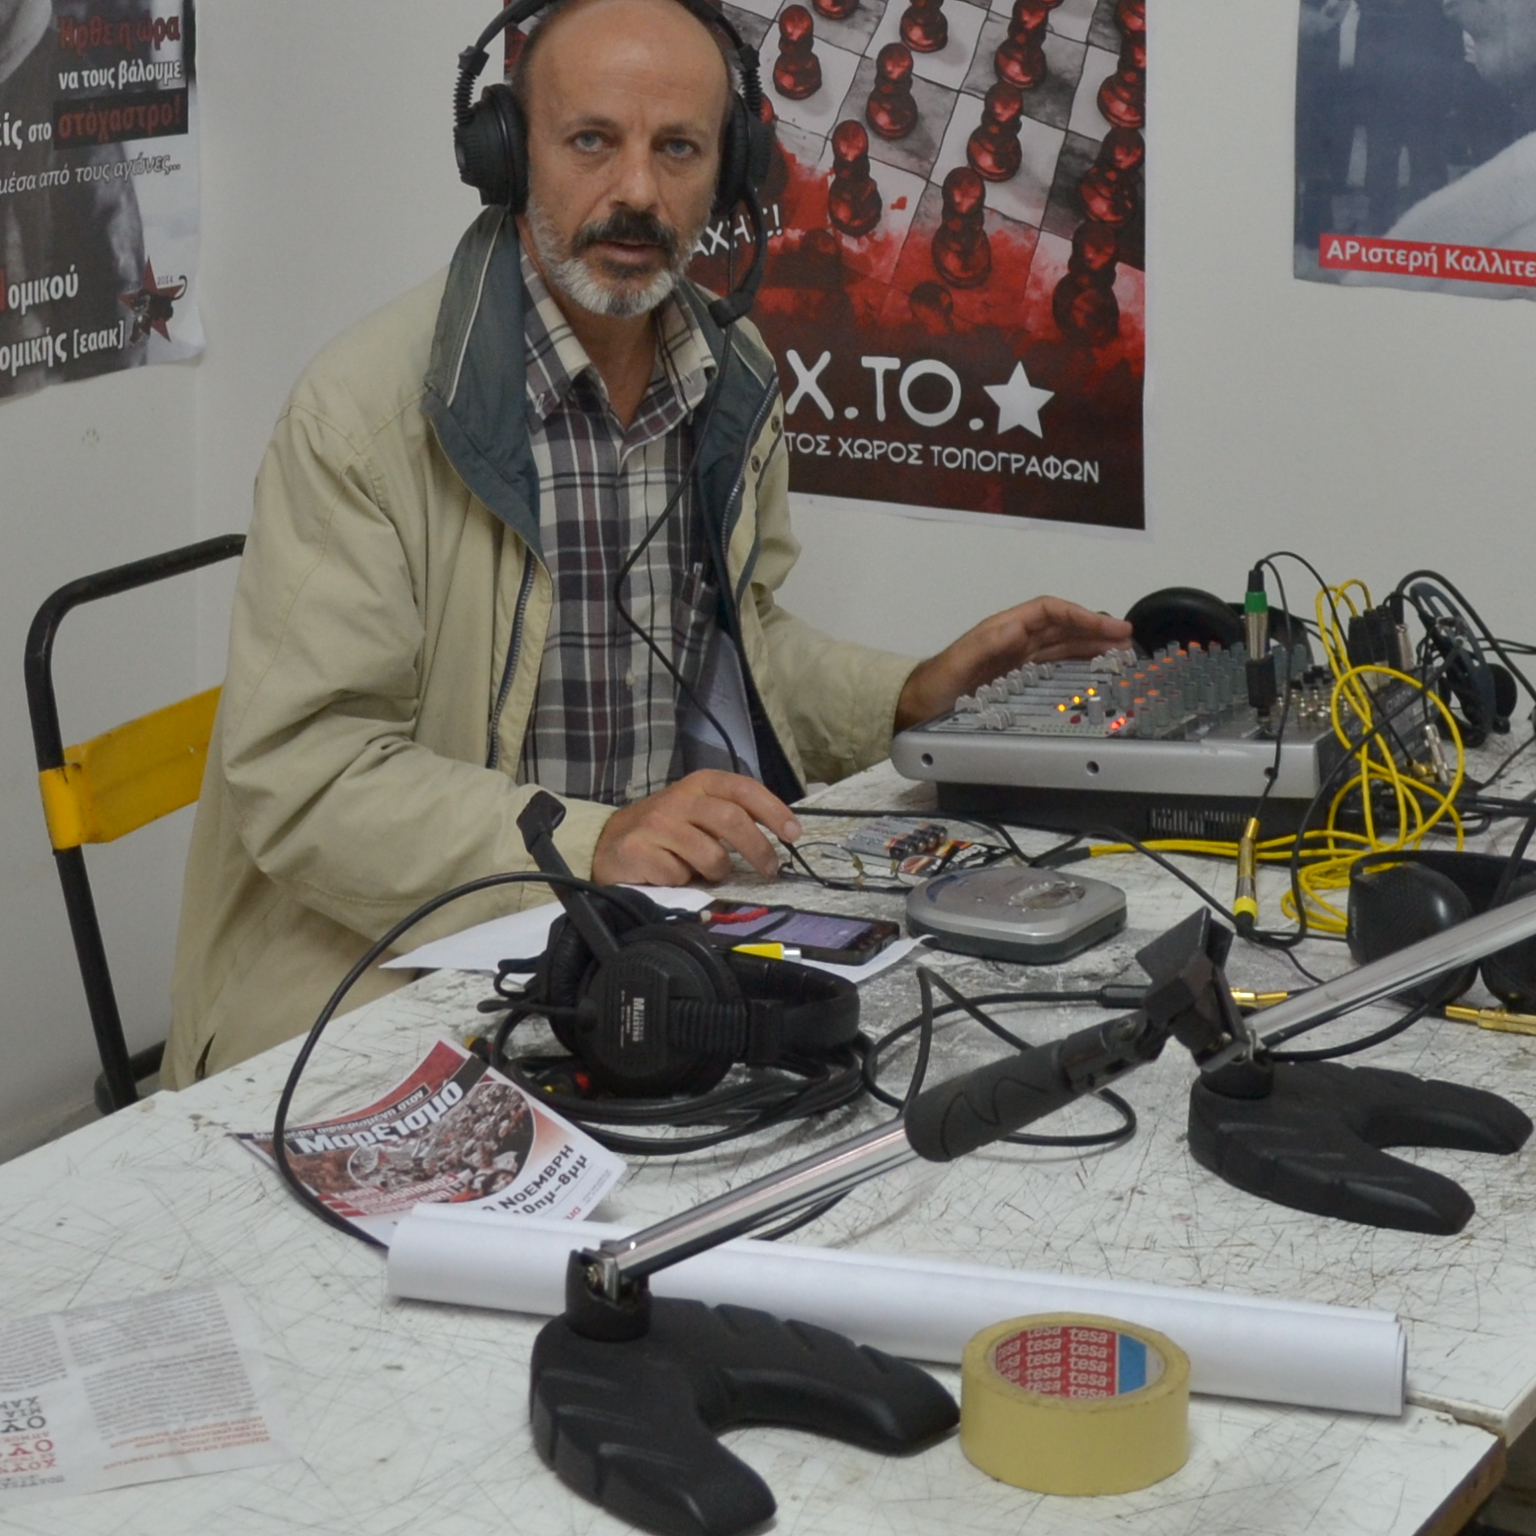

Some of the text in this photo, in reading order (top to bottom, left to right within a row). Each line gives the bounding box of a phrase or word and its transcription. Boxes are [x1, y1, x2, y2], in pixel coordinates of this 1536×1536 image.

[137, 9, 181, 50] ώρα
[59, 59, 182, 90] να τους βάλουμε
[28, 121, 52, 143] στο
[39, 163, 70, 189] από
[75, 162, 110, 187] τους
[1327, 239, 1438, 274] ΑΡιστερή
[838, 437, 923, 466] ΧΩΡΟΣ
[933, 444, 1100, 483] ΤΟΠΟΓΡΑΦΩΝ
[294, 1079, 463, 1154] Μαρξισμό
[498, 1145, 574, 1210] ΝΟΕΜΒΡΗ
[1026, 1337, 1062, 1352] tesa
[1069, 1327, 1109, 1344] tesa
[1026, 1352, 1062, 1367] tesa
[1068, 1342, 1108, 1358] tesa
[1026, 1366, 1062, 1381] tesa
[1068, 1356, 1108, 1372] tesa
[1068, 1371, 1108, 1387] tesa
